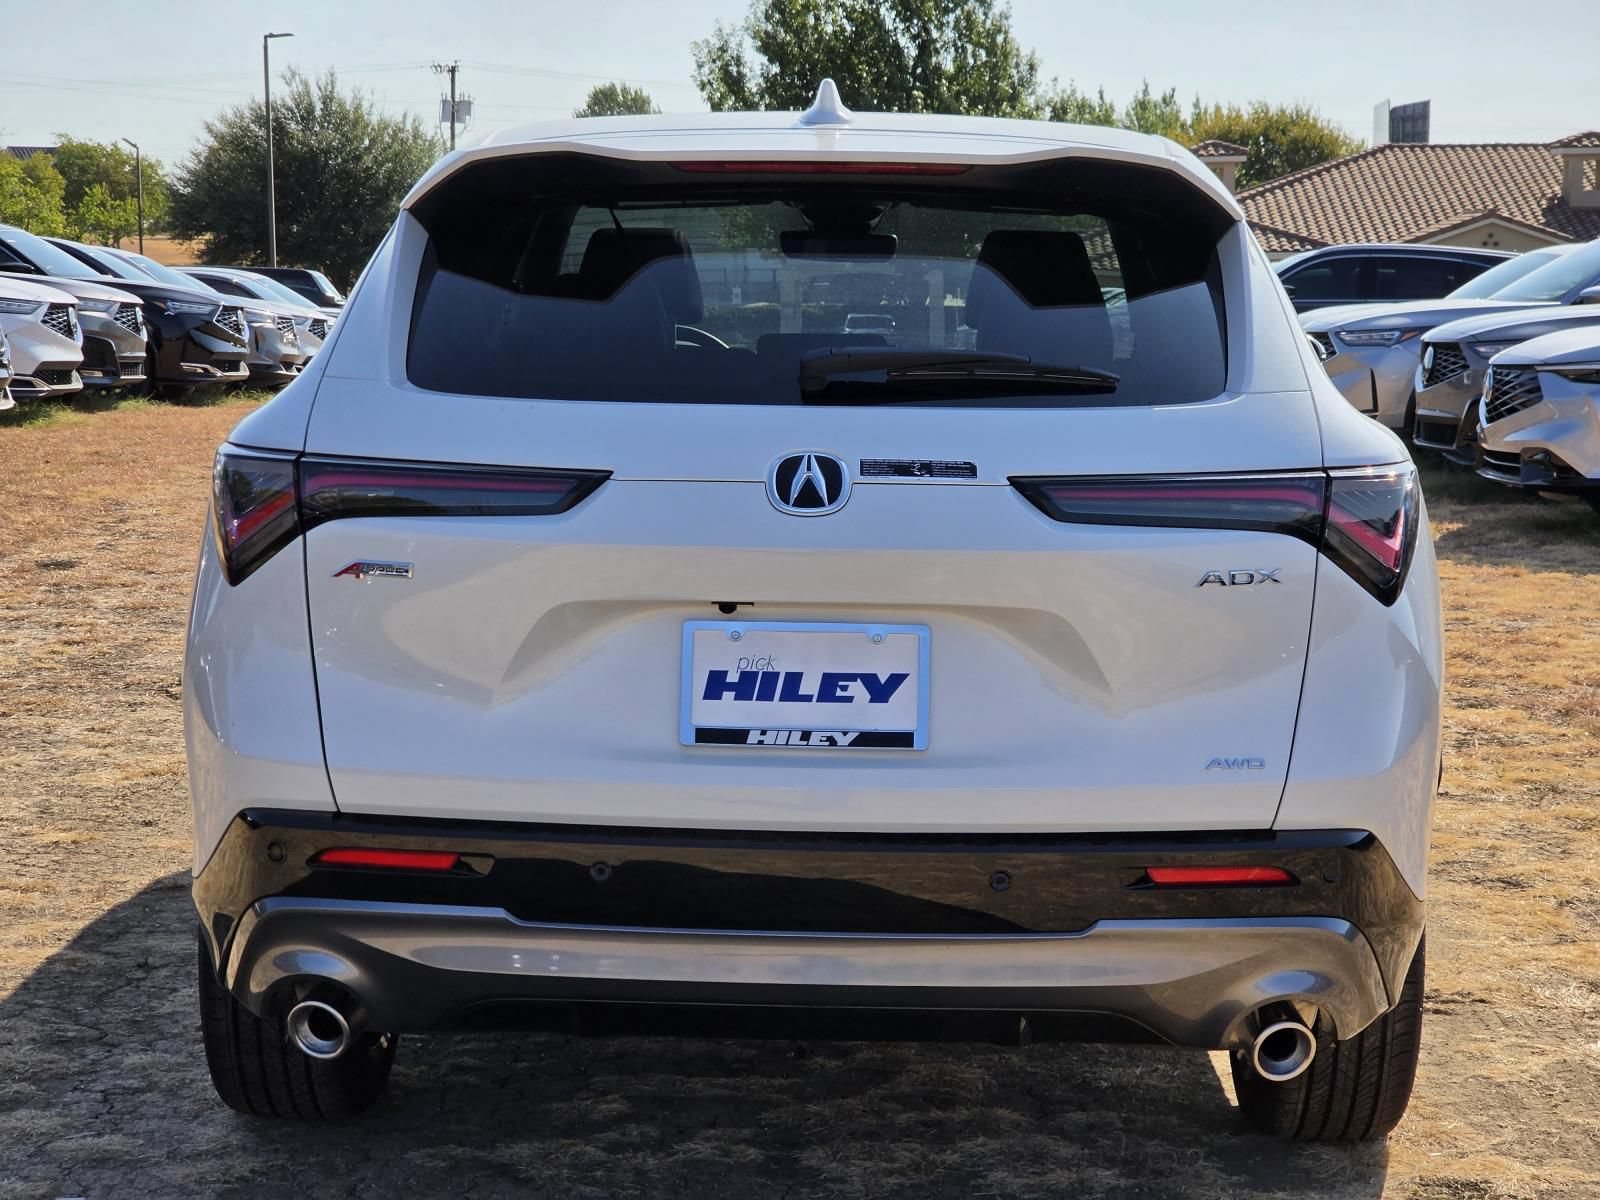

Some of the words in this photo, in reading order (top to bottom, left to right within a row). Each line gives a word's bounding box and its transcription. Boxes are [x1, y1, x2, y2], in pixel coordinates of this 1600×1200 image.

[1196, 568, 1281, 587] ADX
[736, 654, 776, 673] pick
[702, 670, 910, 703] HILEY
[746, 730, 860, 746] HILEY
[1205, 758, 1265, 769] AWD
